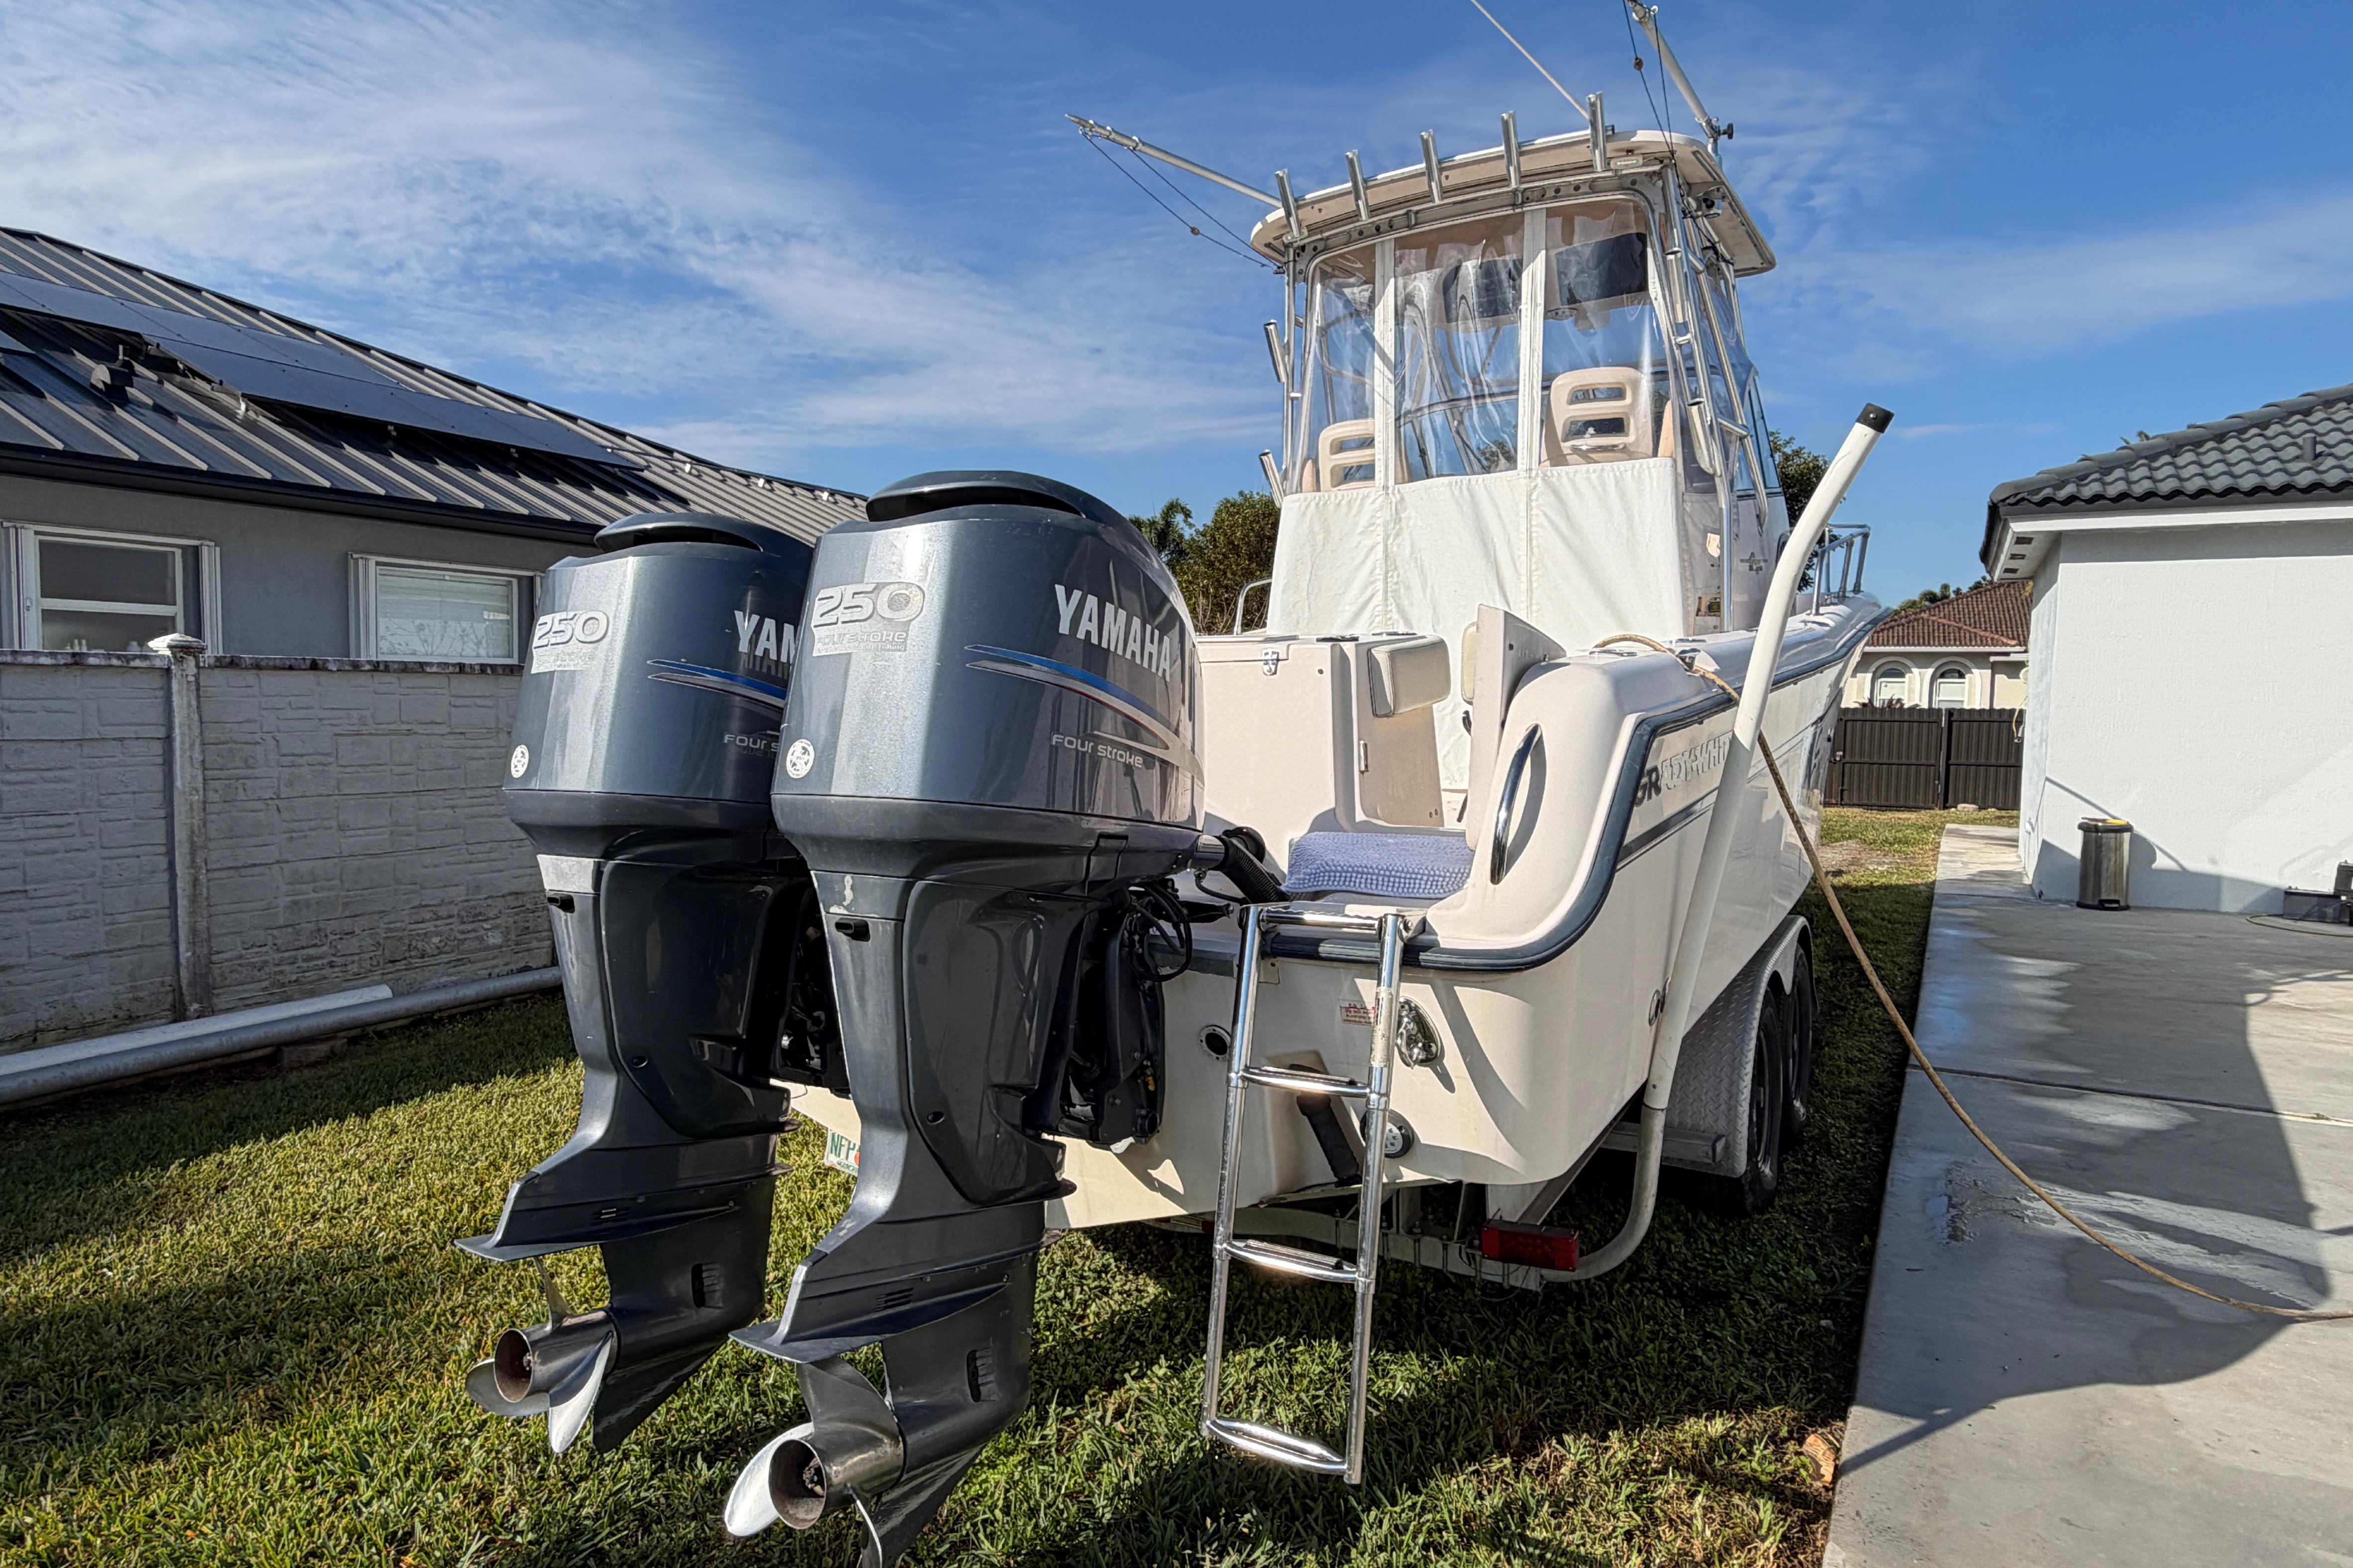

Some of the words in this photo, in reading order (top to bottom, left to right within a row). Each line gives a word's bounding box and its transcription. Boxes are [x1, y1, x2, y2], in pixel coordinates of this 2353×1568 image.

[812, 582, 924, 628] 250
[533, 610, 609, 649] 250
[1054, 584, 1170, 682] YAMAHA
